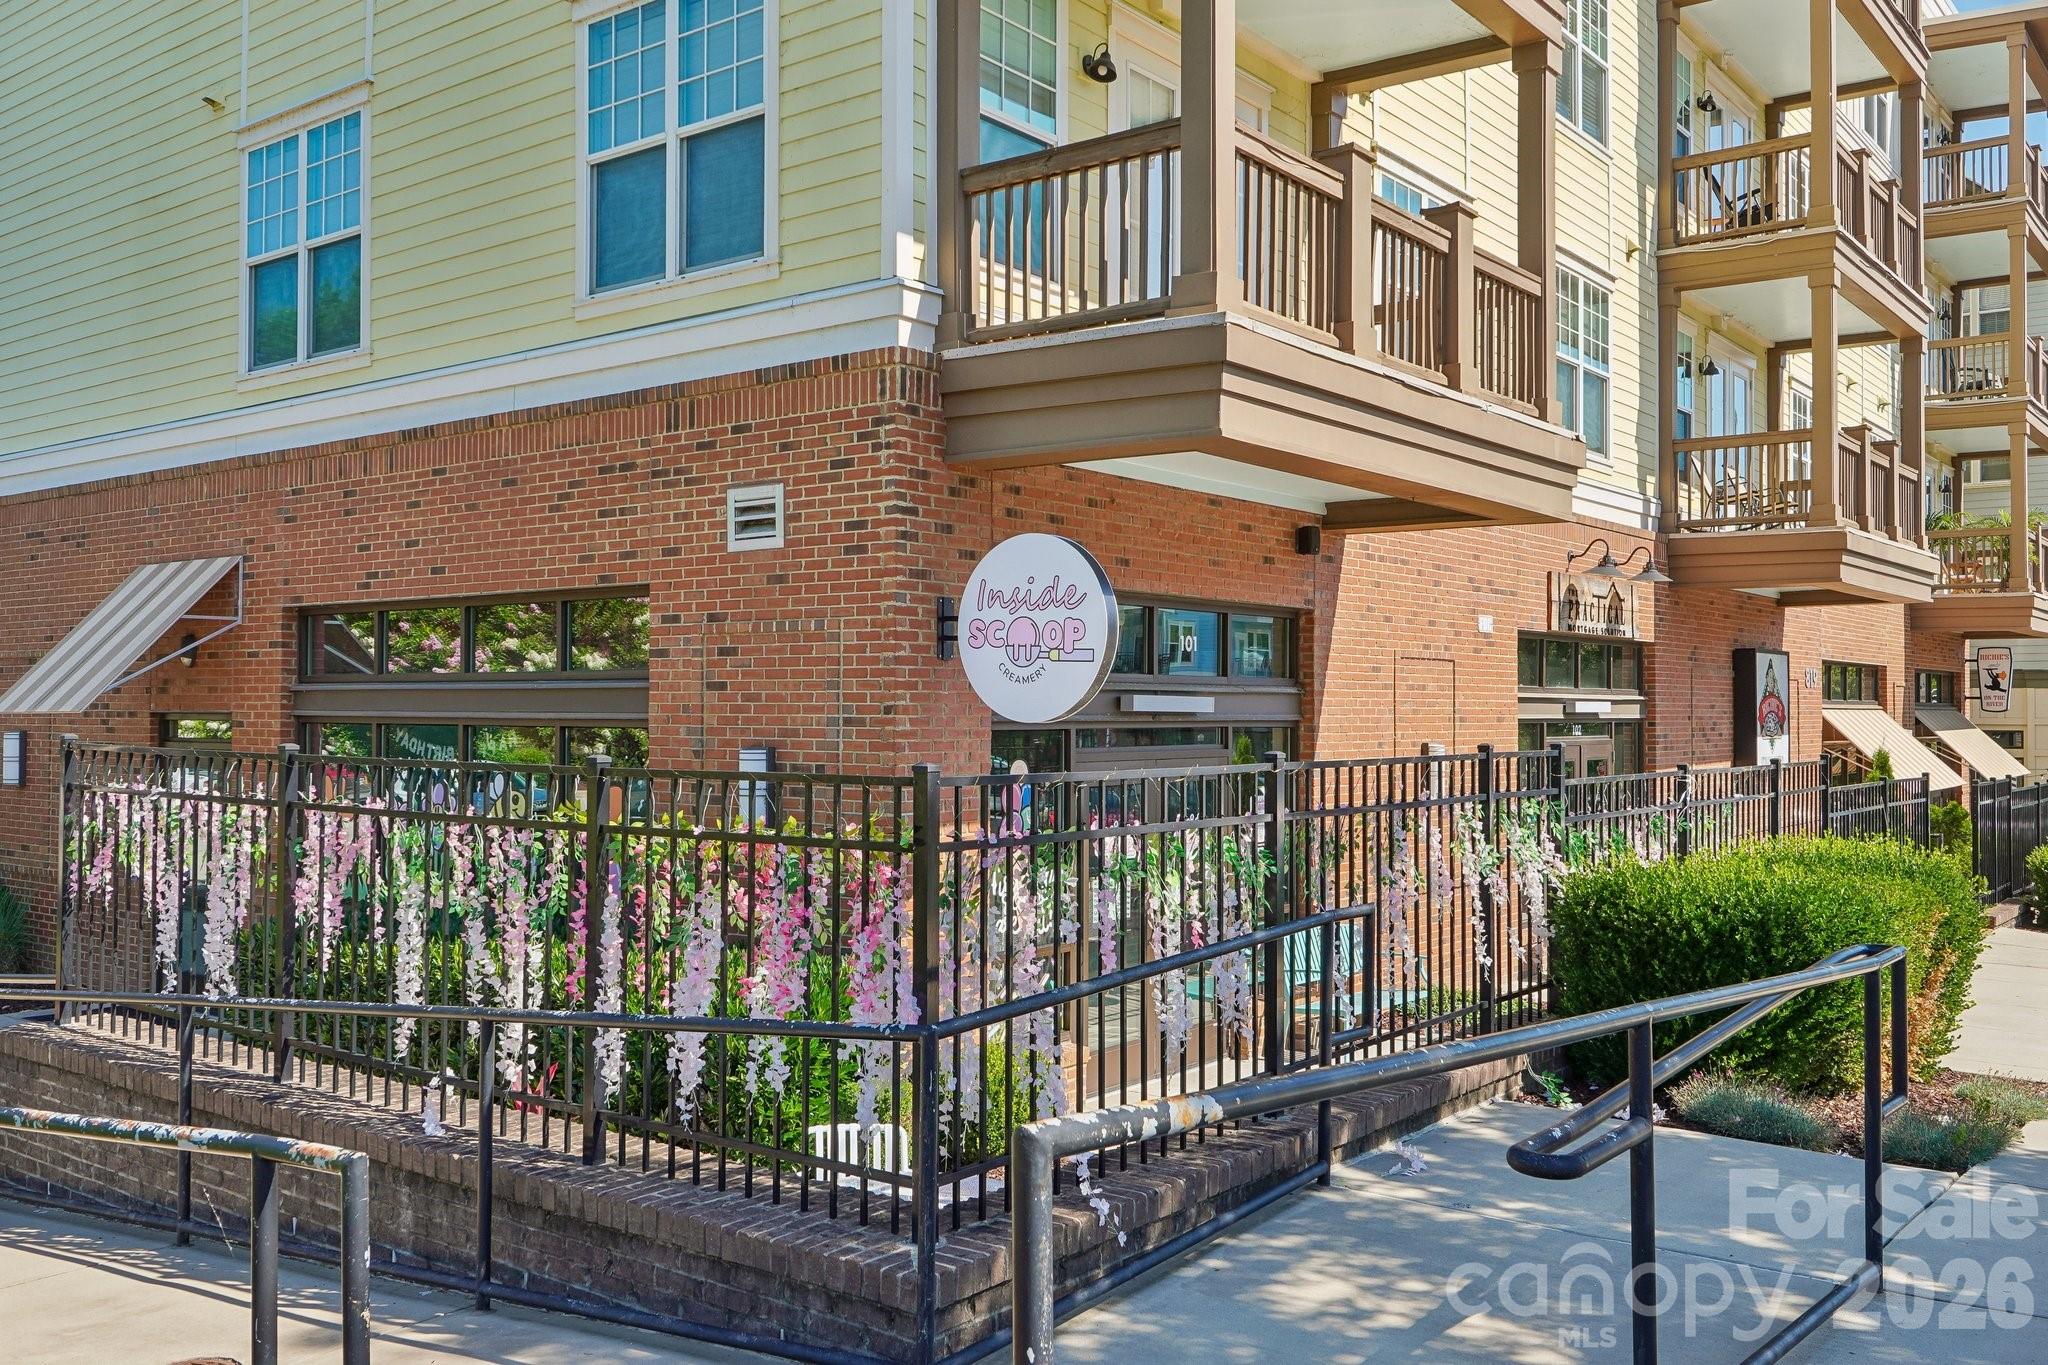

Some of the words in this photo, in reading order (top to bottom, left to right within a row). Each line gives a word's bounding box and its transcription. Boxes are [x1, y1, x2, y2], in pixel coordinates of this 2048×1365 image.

[977, 575, 1087, 615] Inside
[1567, 594, 1625, 625] PRACTICAL
[1568, 624, 1598, 634] MORTGAGE
[1180, 636, 1197, 651] 101
[998, 662, 1047, 685] CREAMERY
[1572, 724, 1582, 736] 102
